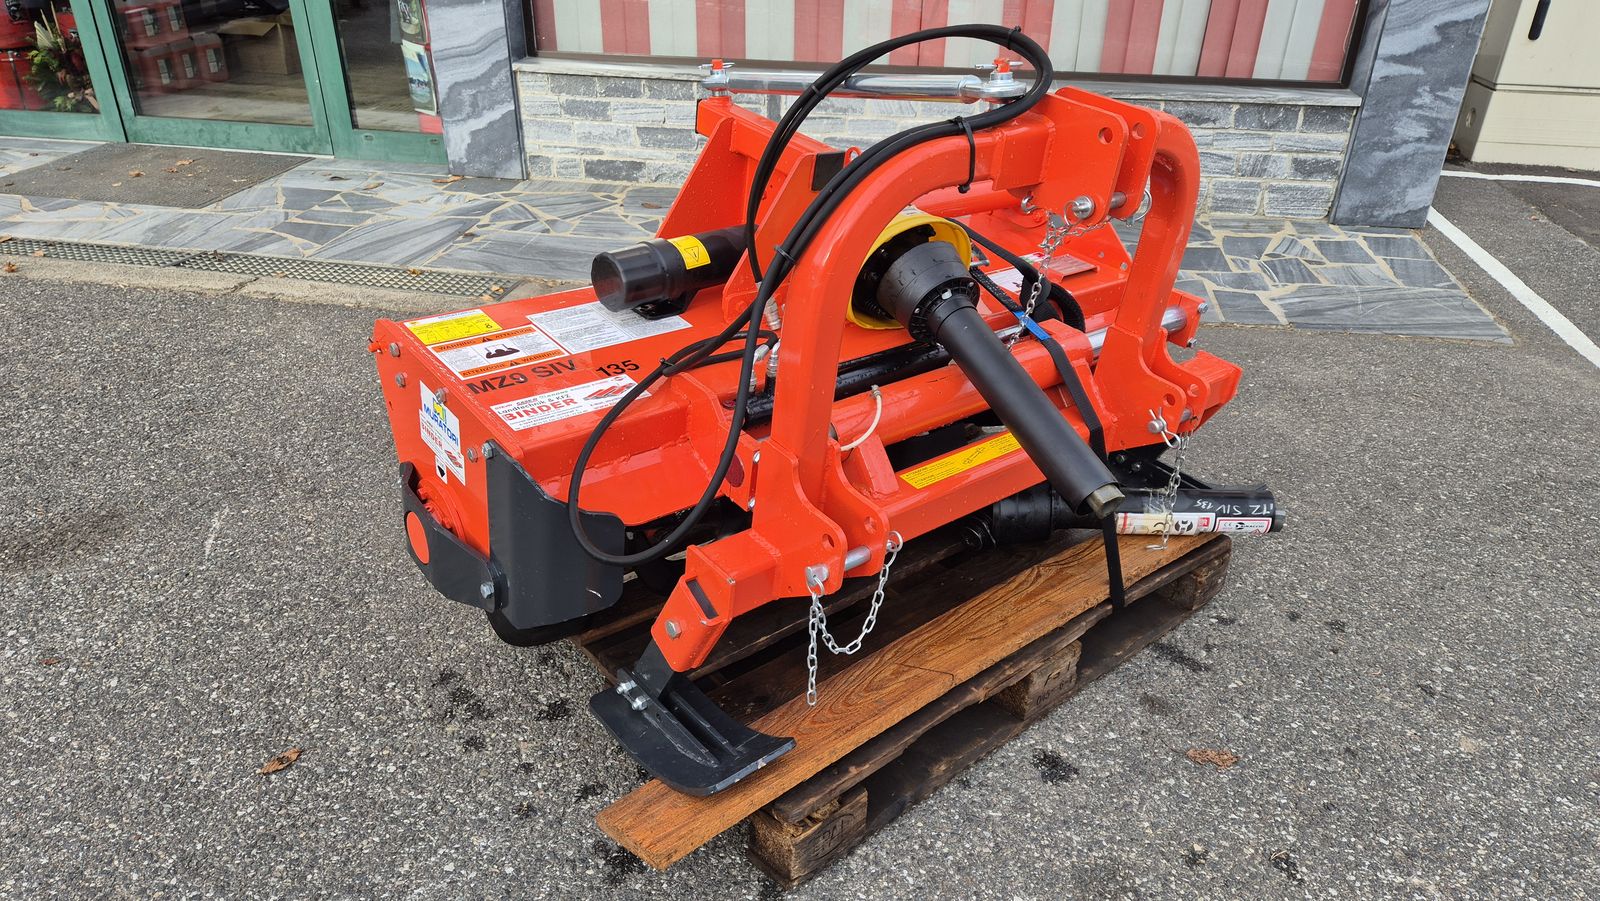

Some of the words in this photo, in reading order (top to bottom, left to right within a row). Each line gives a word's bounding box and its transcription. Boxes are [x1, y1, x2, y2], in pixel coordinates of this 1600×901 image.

[466, 372, 529, 395] MZ9
[531, 359, 577, 378] SIV
[595, 359, 640, 377] 135
[497, 400, 545, 415] Landtechnik
[504, 398, 578, 421] BINDER
[423, 403, 459, 447] MURATORI
[1193, 498, 1214, 510] 135
[1215, 504, 1243, 516] SIV
